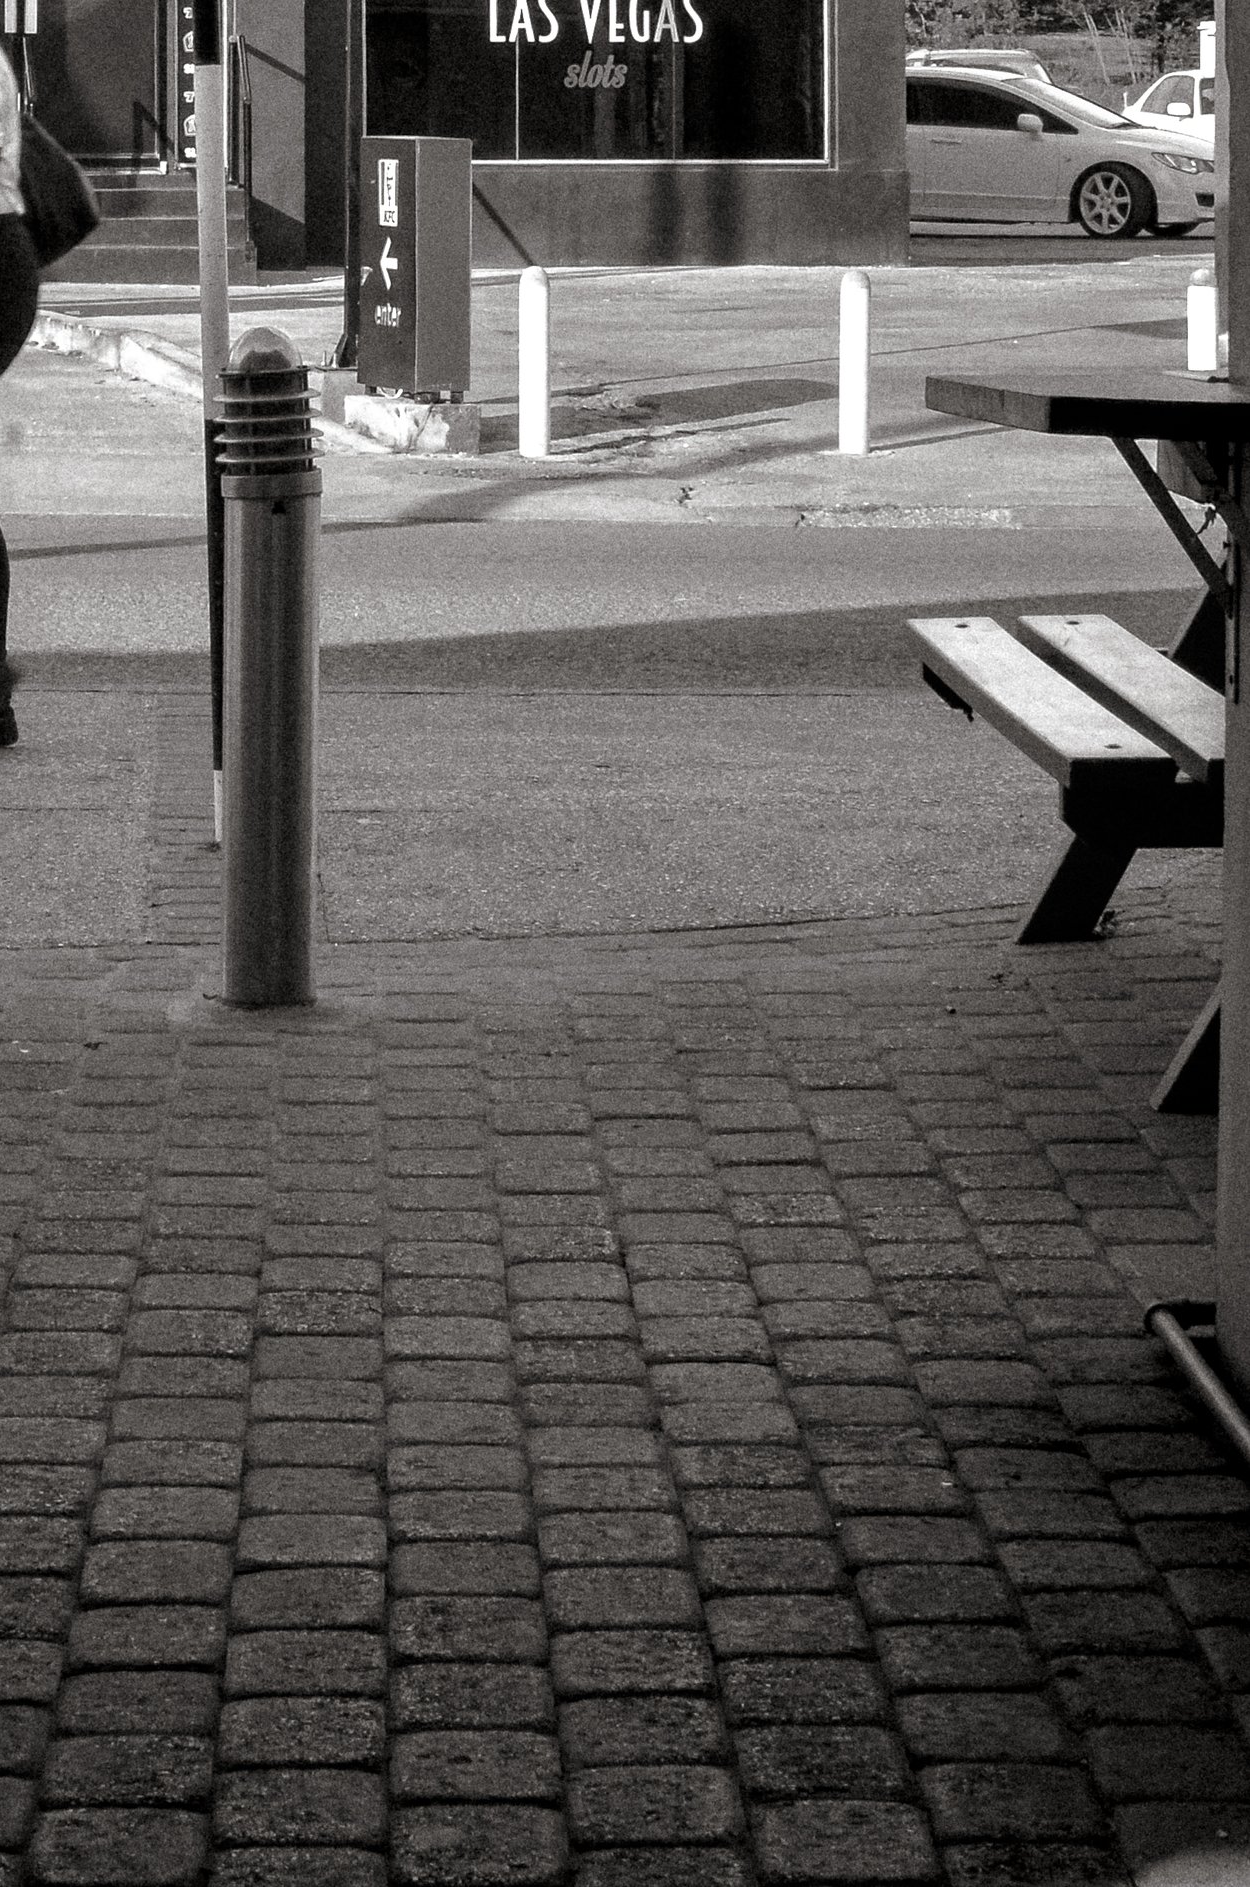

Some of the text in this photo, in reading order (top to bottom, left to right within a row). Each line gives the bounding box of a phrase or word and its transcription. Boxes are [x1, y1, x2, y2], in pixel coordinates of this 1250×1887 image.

[564, 50, 628, 89] slots
[383, 210, 396, 224] KFC
[374, 302, 402, 328] enter
